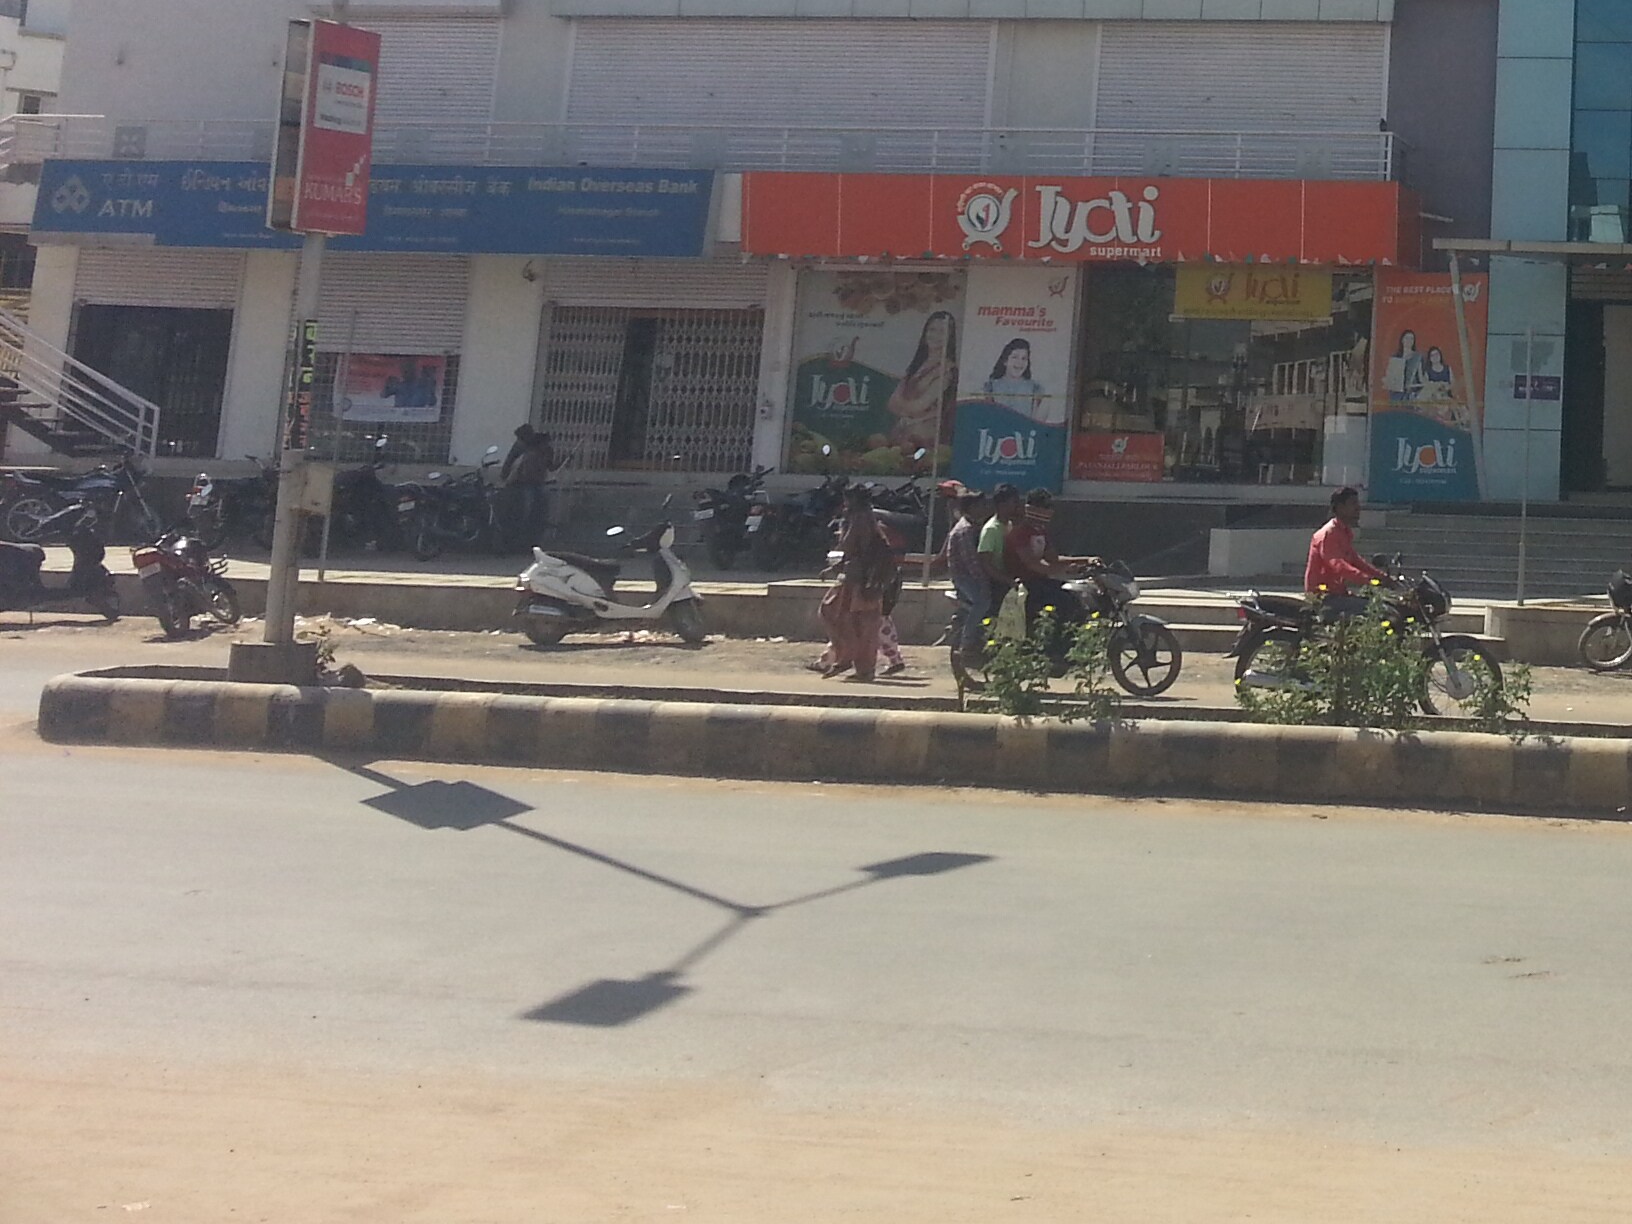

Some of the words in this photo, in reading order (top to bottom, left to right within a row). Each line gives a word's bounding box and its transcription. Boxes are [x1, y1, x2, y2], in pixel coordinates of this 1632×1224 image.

[528, 177, 576, 193] Indian
[581, 177, 654, 193] Overseas
[659, 178, 698, 194] Bank
[98, 199, 154, 218] ATM
[1028, 185, 1162, 253] Jyoti
[1089, 245, 1163, 259] supermart
[977, 305, 1047, 318] mamma's
[995, 317, 1055, 327] Favourite
[809, 375, 870, 411] Jyoti
[972, 428, 1038, 465] Jyoti
[1392, 437, 1458, 474] Jyoti
